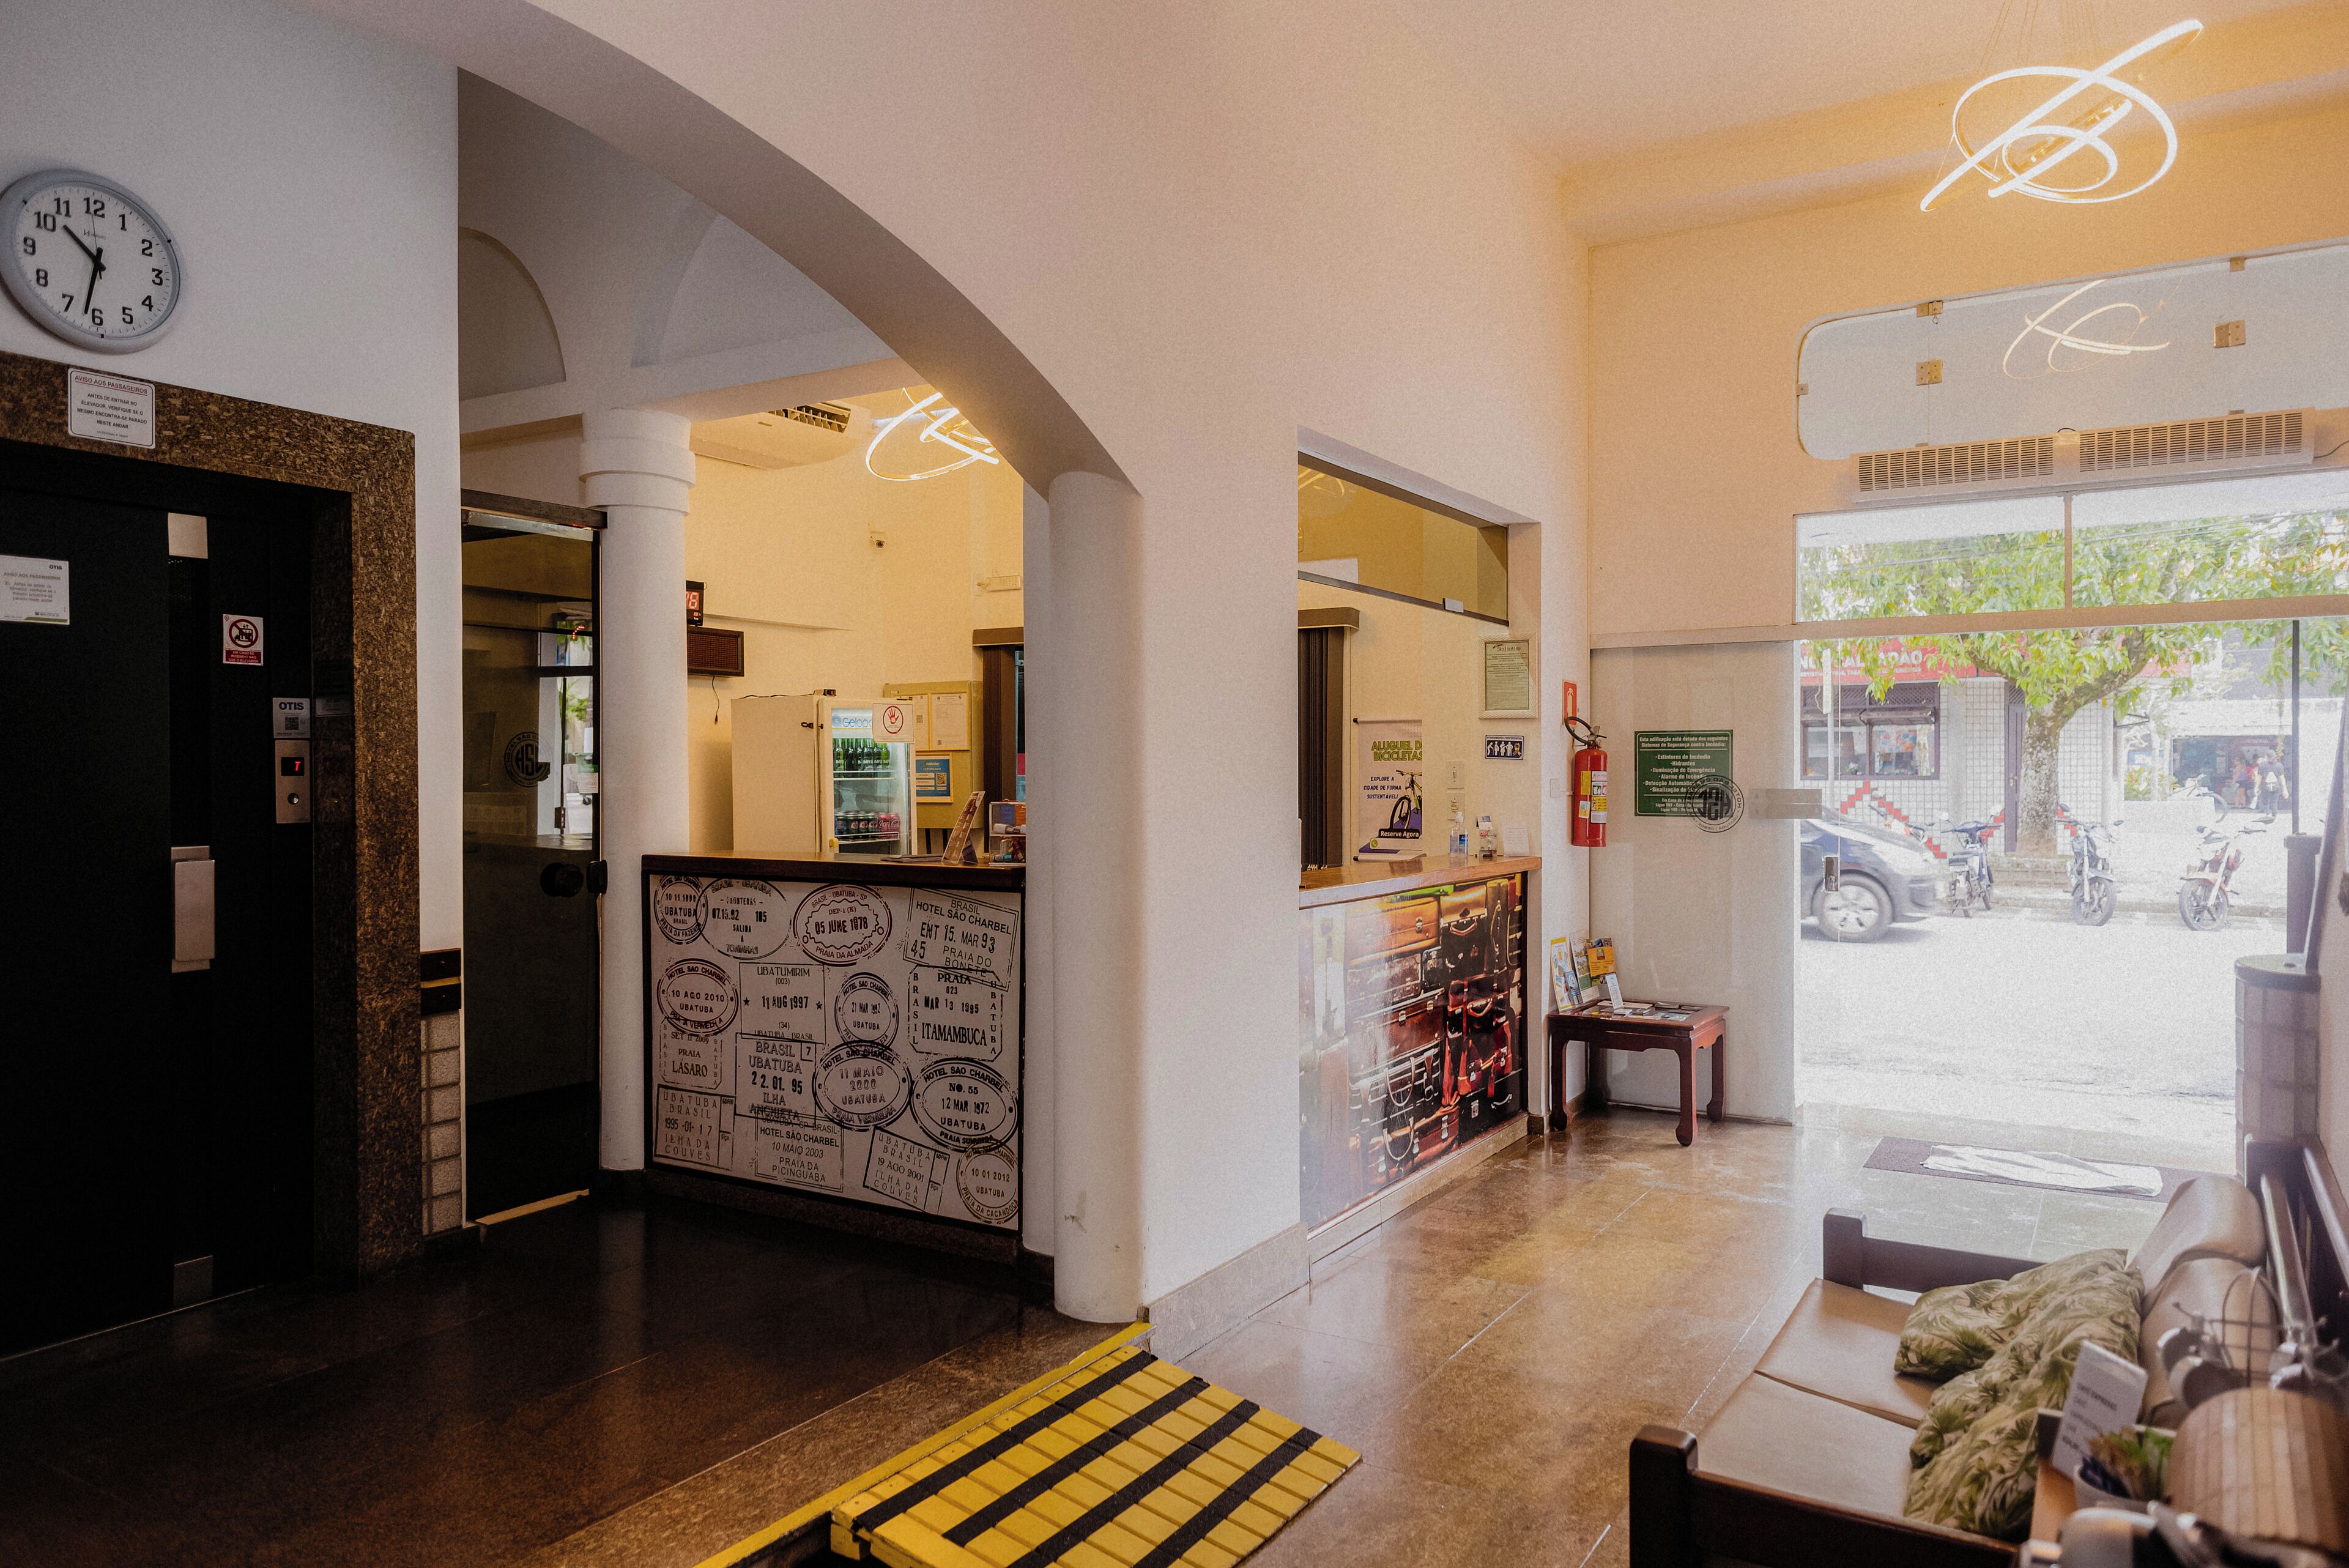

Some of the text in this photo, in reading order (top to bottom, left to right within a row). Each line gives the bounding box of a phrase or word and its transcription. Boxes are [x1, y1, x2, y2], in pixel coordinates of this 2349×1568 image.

[54, 197, 72, 218] 11
[83, 197, 105, 218] 12
[34, 211, 56, 232] 10
[119, 214, 127, 231] 1
[23, 237, 36, 256] 9
[141, 239, 153, 258] 2
[35, 268, 48, 288] 8
[152, 268, 163, 286] 3
[62, 294, 74, 312] 7
[141, 295, 154, 312] 4
[92, 308, 103, 327] 6
[122, 306, 133, 325] 5
[75, 375, 92, 384] AVISO
[108, 382, 147, 394] PASSAGEIROS
[95, 411, 128, 421] ENCONTRA-SE
[108, 404, 132, 414] VERIFIQUE
[279, 702, 304, 710] OTIS
[1371, 740, 1422, 751] ALUGUEL D
[1373, 751, 1422, 761] BICICLETAS
[811, 893, 828, 908] BRASIL
[951, 899, 981, 915] BRASIL
[665, 907, 697, 918] UBATUBA
[916, 900, 1012, 935] HOTEL SÃO CHARBEL
[828, 920, 848, 934] JUNE
[961, 931, 979, 948] MAR
[815, 946, 834, 959] PRAIA
[847, 940, 874, 959] ALMADA
[943, 945, 992, 967] PRAIA DO
[757, 967, 810, 976] UBATUMIRIM
[937, 973, 972, 985] PRAIA
[671, 989, 725, 1003] 10 2010
[772, 995, 809, 1009] AUG 1997
[924, 995, 939, 1010] MAR
[680, 1003, 714, 1014] UBATUBA
[853, 1020, 880, 1031] UBATUBA
[921, 1022, 987, 1046] ITAMAMBUCA
[678, 1048, 701, 1058] PRAIA
[755, 1041, 795, 1058] BRASIL
[806, 1046, 811, 1056] 7
[672, 1058, 708, 1077] LÁSARO
[749, 1055, 803, 1074] UBATUBA
[823, 1053, 844, 1071] HOTEL
[853, 1066, 884, 1079] MAIO
[923, 1068, 948, 1083] HOTEL
[969, 1069, 1006, 1093] CHARBEL
[792, 1078, 803, 1095] 95
[850, 1079, 877, 1091] 2000
[968, 1086, 979, 1094] 55
[664, 1091, 717, 1109] UBATUBA
[763, 1091, 787, 1106] ILHA
[842, 1093, 886, 1105] UBATUBA
[942, 1097, 968, 1112] 12 MAR
[669, 1104, 710, 1119] BRASIL
[940, 1117, 986, 1131] UBATUBA
[666, 1134, 710, 1150] ILHA DA
[760, 1127, 839, 1147] HOTEL SÃO CHARBEL
[940, 1131, 960, 1144] PRAIA
[665, 1145, 710, 1161] COUVES
[771, 1141, 823, 1158] 10 MAIO 2003
[878, 1133, 930, 1161] UBATUBA
[779, 1156, 819, 1172] PRAIA DA
[883, 1145, 923, 1168] BRASIL
[772, 1165, 826, 1183] PICINGUABA
[875, 1169, 900, 1187] ILHA
[886, 1161, 924, 1183] AGO 2001
[971, 1168, 1010, 1183] 10 2012
[874, 1180, 918, 1204] COUVES
[976, 1186, 1004, 1198] UBATUBA
